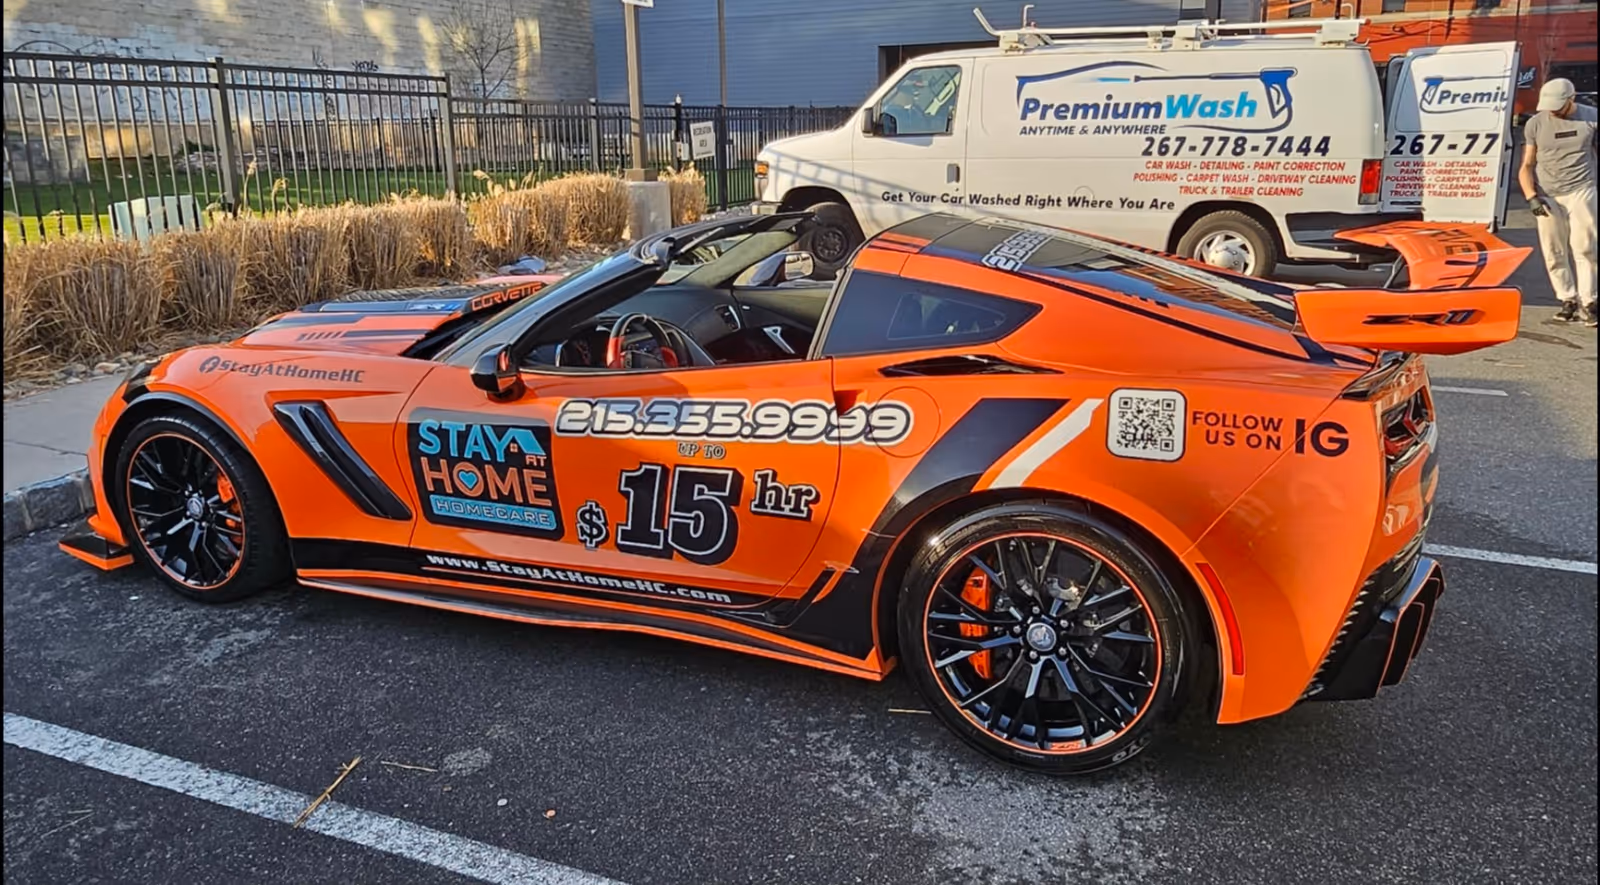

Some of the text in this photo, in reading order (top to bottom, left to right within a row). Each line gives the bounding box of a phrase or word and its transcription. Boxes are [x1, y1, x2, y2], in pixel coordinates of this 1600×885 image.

[1019, 125, 1167, 136] ANYTIME & ANYWHERE
[1141, 136, 1331, 157] 267-778-7444
[1145, 160, 1163, 169] CAR
[1166, 161, 1191, 170] WASH
[1200, 161, 1245, 170] DETAILING
[1254, 162, 1280, 170] PAINT
[1283, 162, 1346, 171] CORRECTION
[1133, 173, 1177, 182] POLISHING
[1187, 174, 1219, 183] CARPET
[1222, 174, 1249, 183] WASH
[1258, 174, 1305, 184] DRIVEWAY
[1308, 175, 1357, 184] CLEANING
[882, 191, 1175, 210] Get Your Car Washed Right Where You Are
[1179, 186, 1207, 195] TRUCK
[1221, 187, 1254, 196] TRAILER
[1257, 187, 1304, 197] CLEANING
[471, 282, 542, 311] CORVETTE
[554, 398, 914, 446] 215.355.9999
[1192, 410, 1283, 432] FOLLOW
[418, 418, 518, 463] STAY
[1205, 430, 1282, 450] US ON
[1294, 418, 1349, 457] IG
[525, 454, 547, 467] AT
[677, 441, 726, 459] UP TO
[420, 456, 552, 507] HOME
[751, 468, 820, 522] hr
[436, 499, 551, 525] HOMECARE
[426, 554, 731, 603] www.StayAtHomeHC.com
